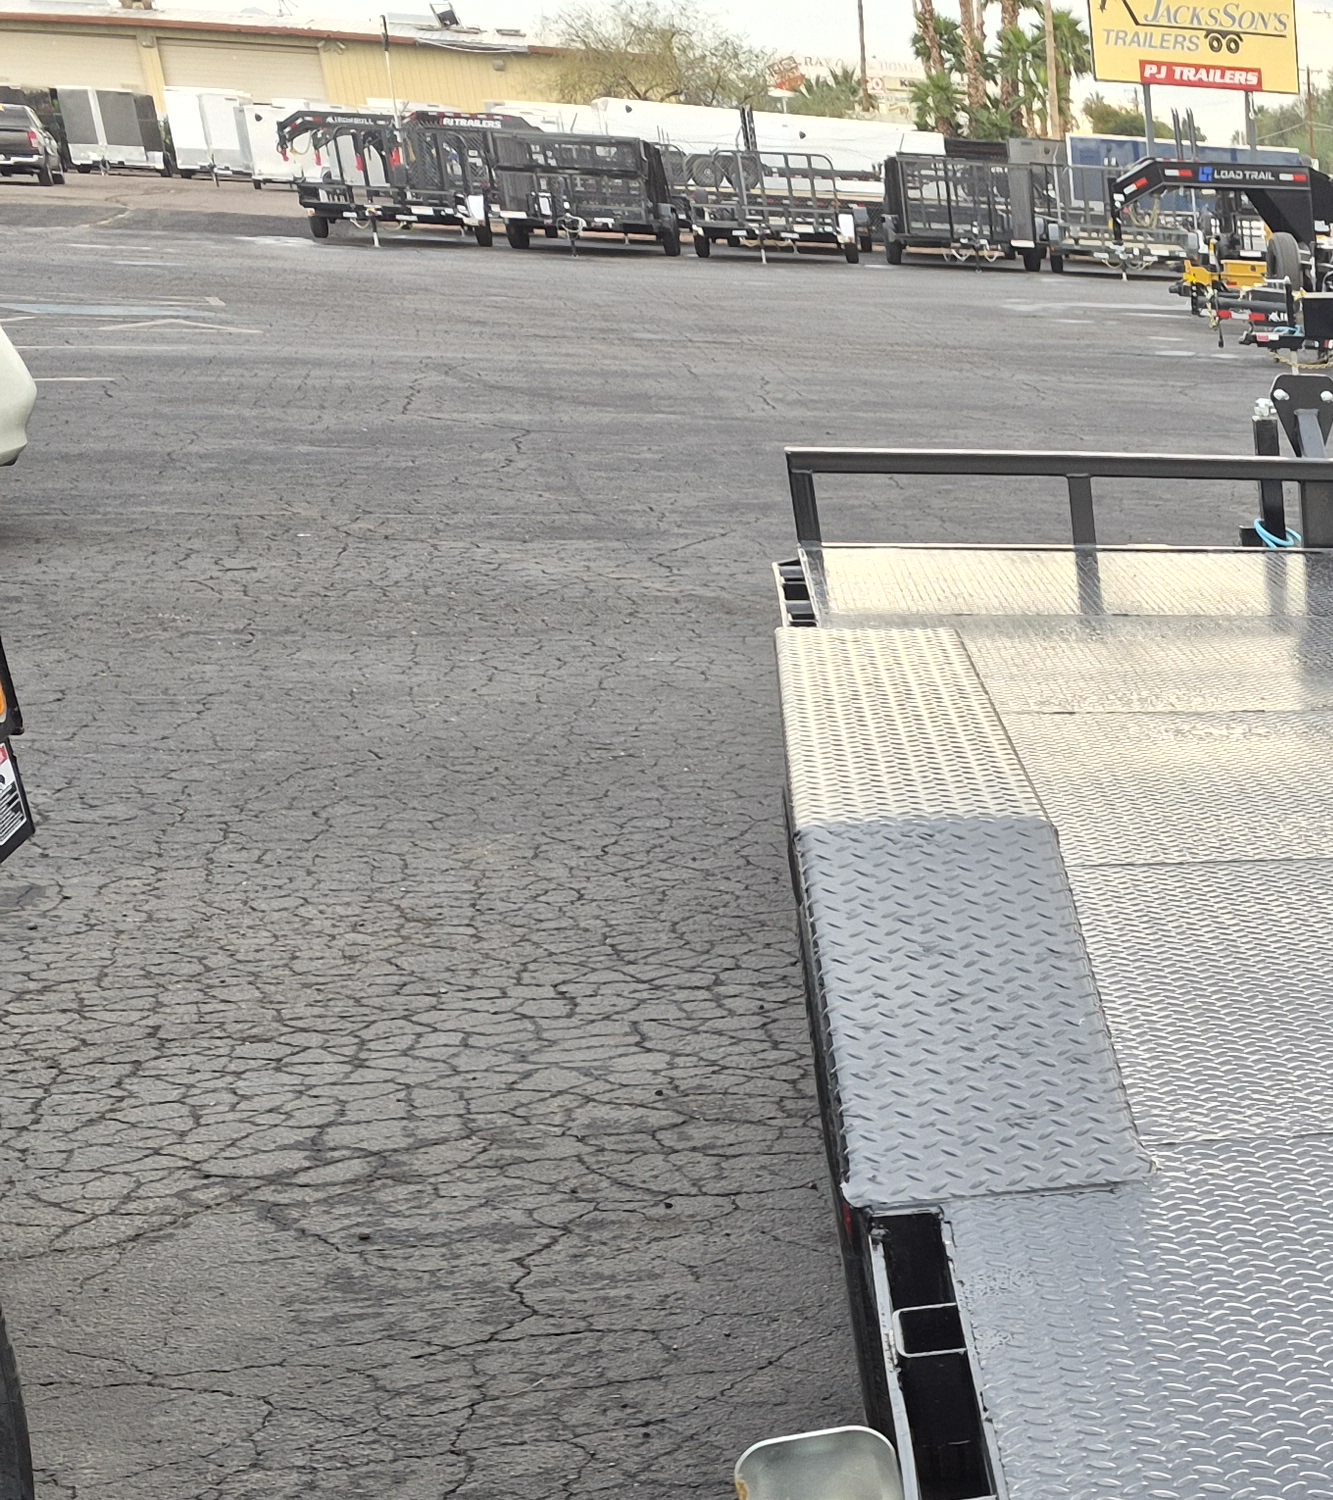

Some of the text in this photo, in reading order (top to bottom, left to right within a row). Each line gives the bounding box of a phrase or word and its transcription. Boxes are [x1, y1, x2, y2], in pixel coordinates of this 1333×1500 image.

[1103, 29, 1200, 52] TRAILERS
[1144, 64, 1259, 86] PJ TRAILERS
[1214, 169, 1275, 180] LOAD TRAIL
